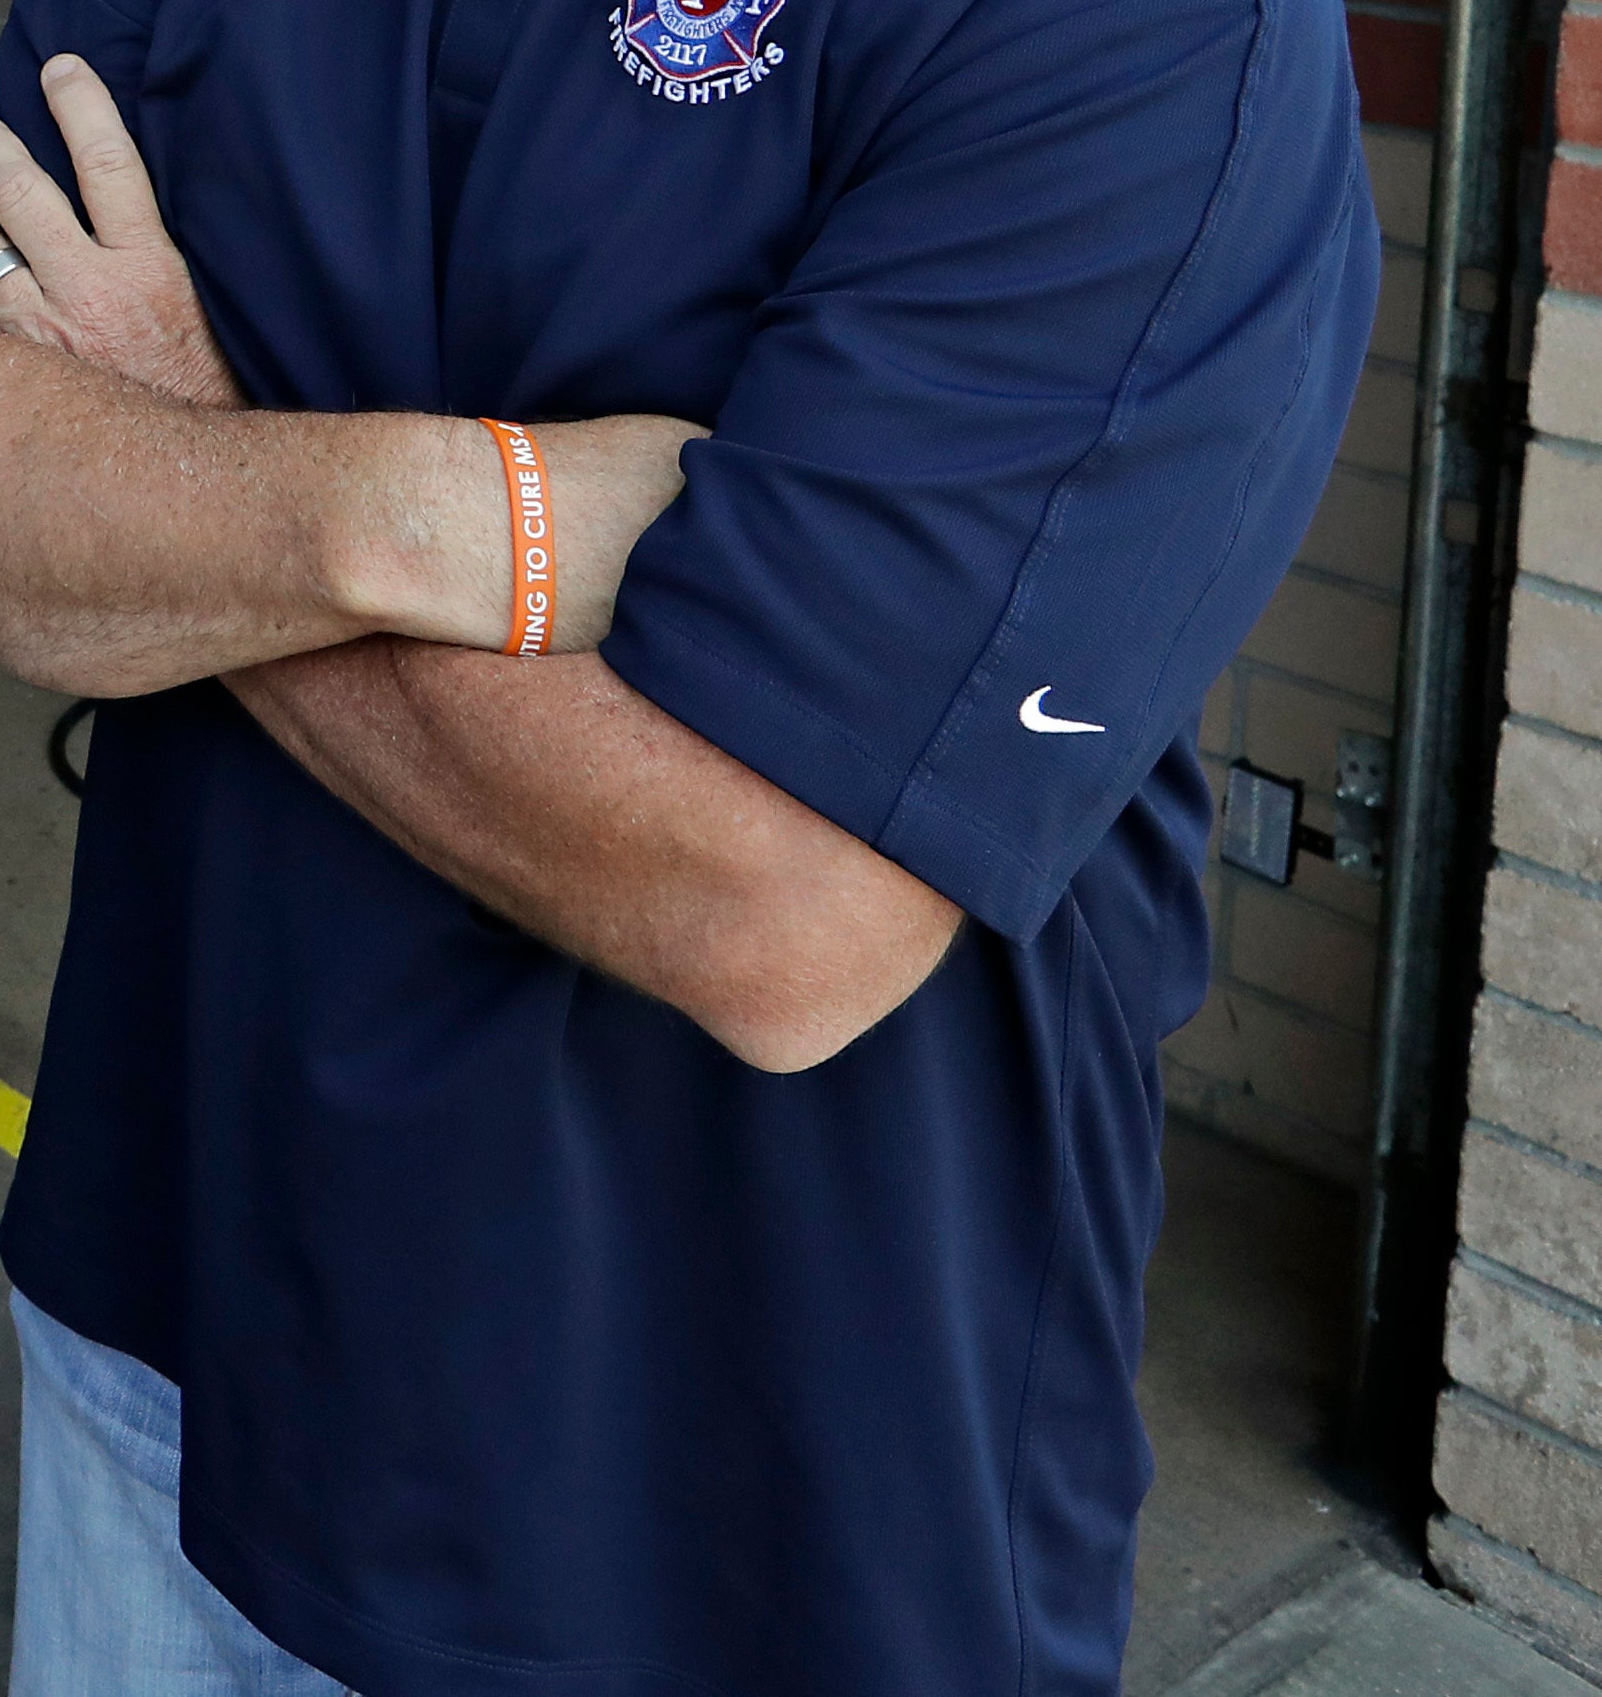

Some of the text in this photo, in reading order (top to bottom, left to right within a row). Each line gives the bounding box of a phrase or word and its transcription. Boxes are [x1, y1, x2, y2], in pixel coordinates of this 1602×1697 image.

[608, 7, 785, 104] FIREFIGHTERS
[654, 35, 707, 66] 2117
[510, 437, 537, 466] MS
[518, 470, 546, 539] CURE
[526, 546, 547, 582] TO
